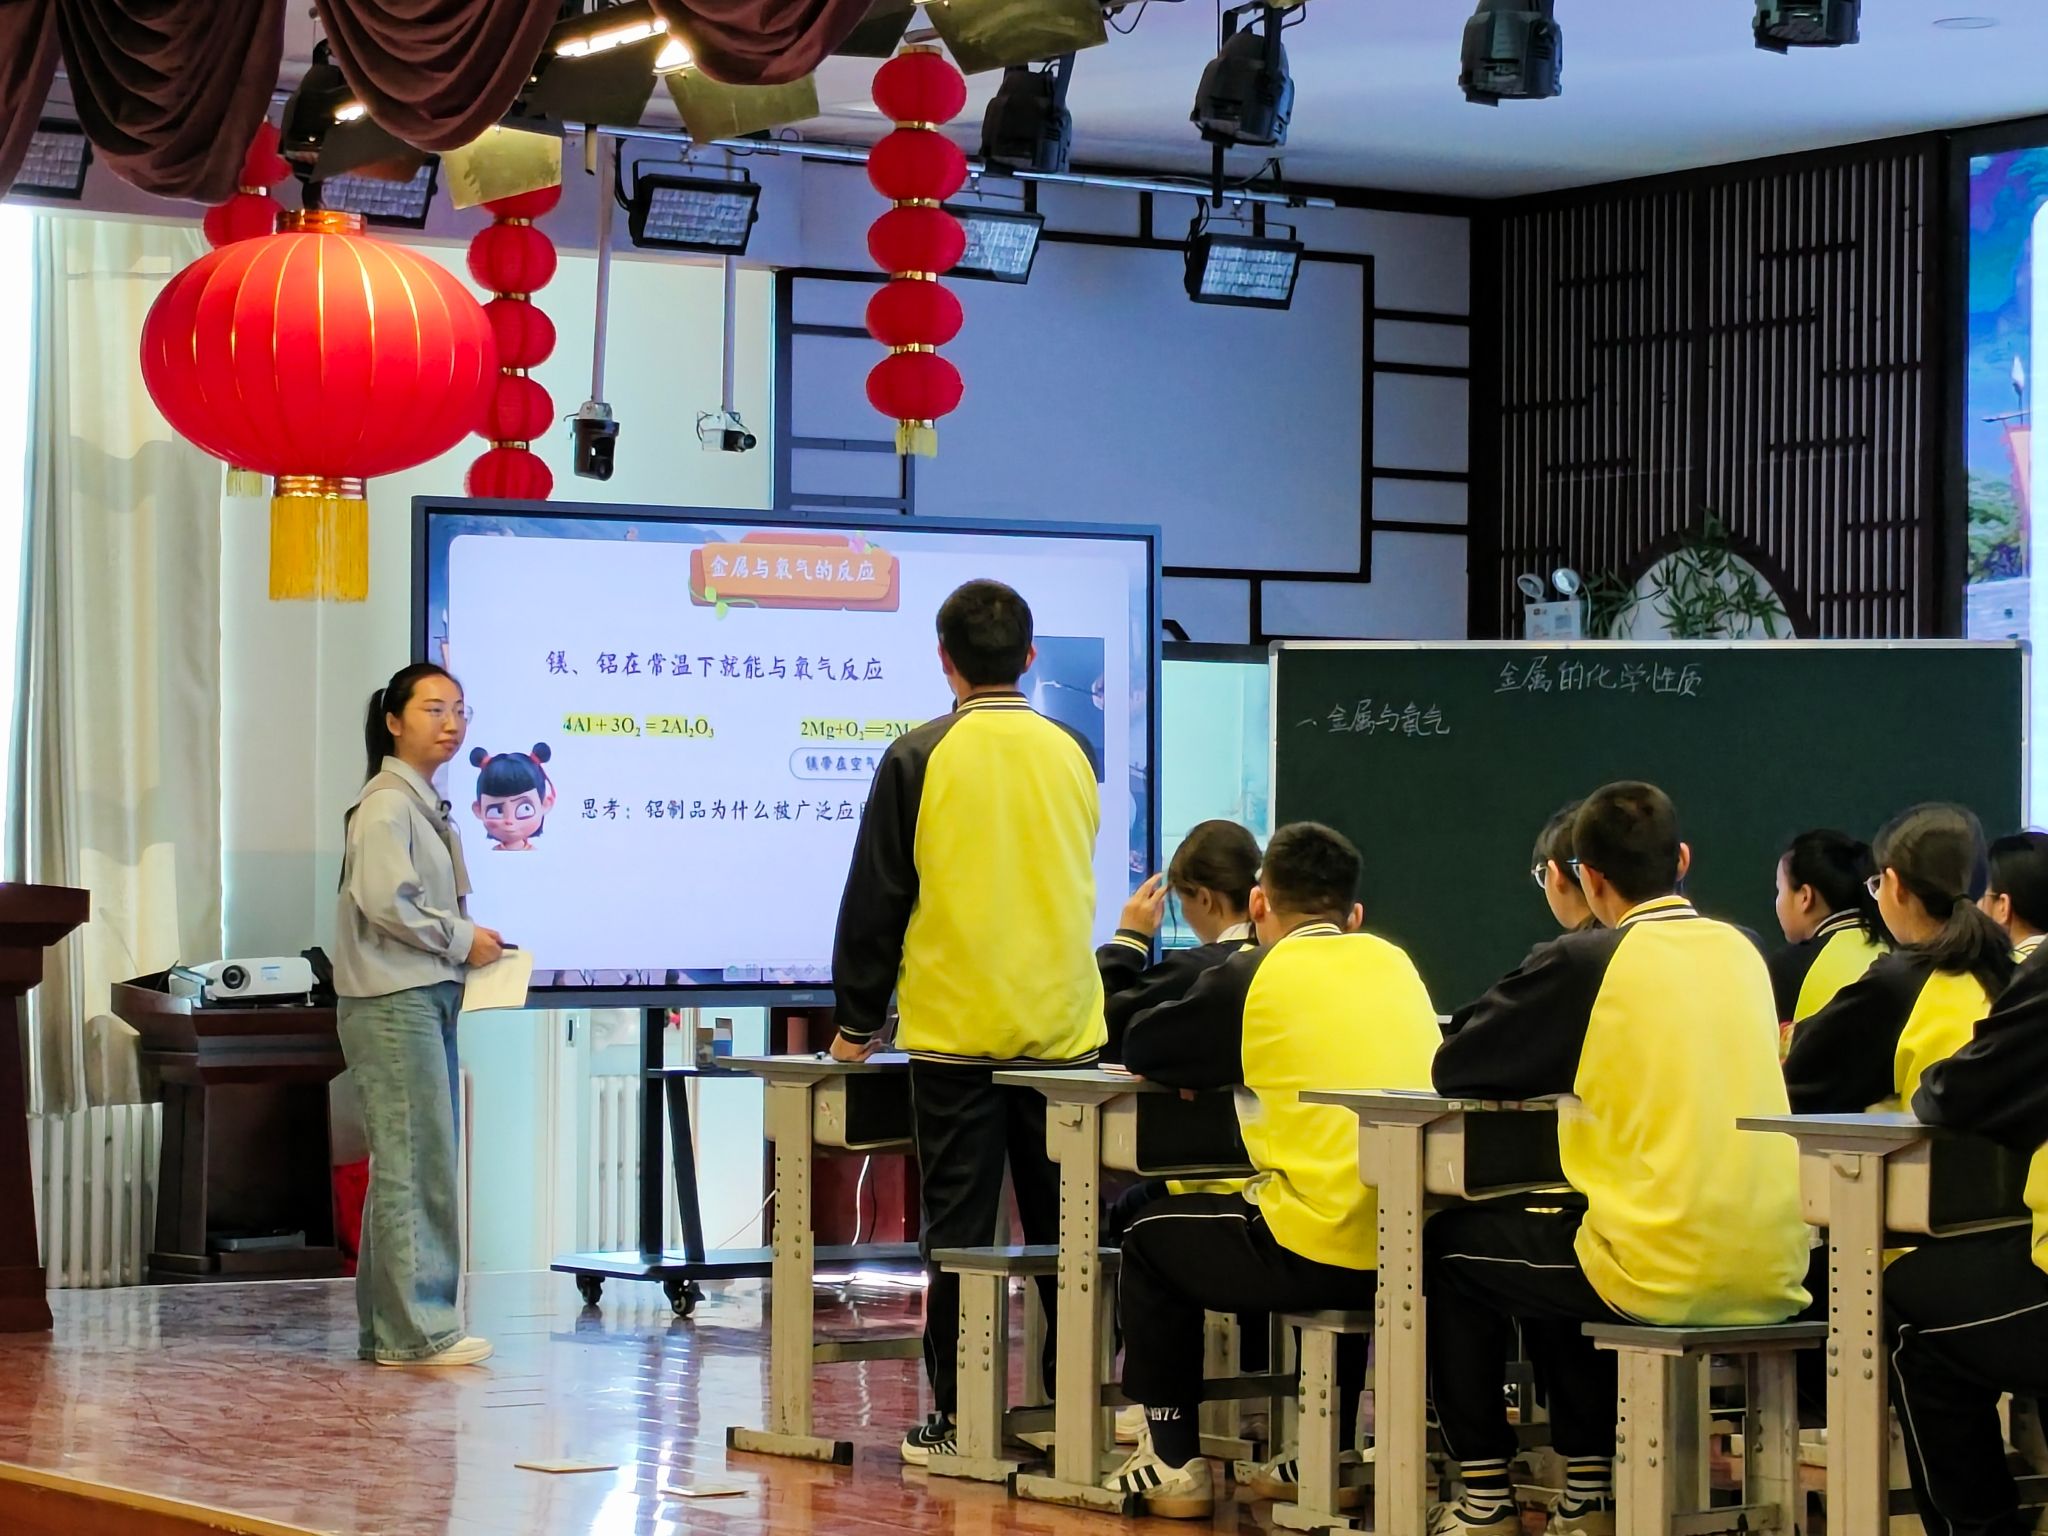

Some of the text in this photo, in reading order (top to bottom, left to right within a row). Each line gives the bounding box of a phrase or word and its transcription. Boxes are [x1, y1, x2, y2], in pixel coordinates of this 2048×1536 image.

[710, 555, 876, 582] 金属与氧气的反应
[546, 651, 884, 681] 镁、铝在常温下就能与氧气反应
[1494, 656, 1702, 696] 金属的化学性质
